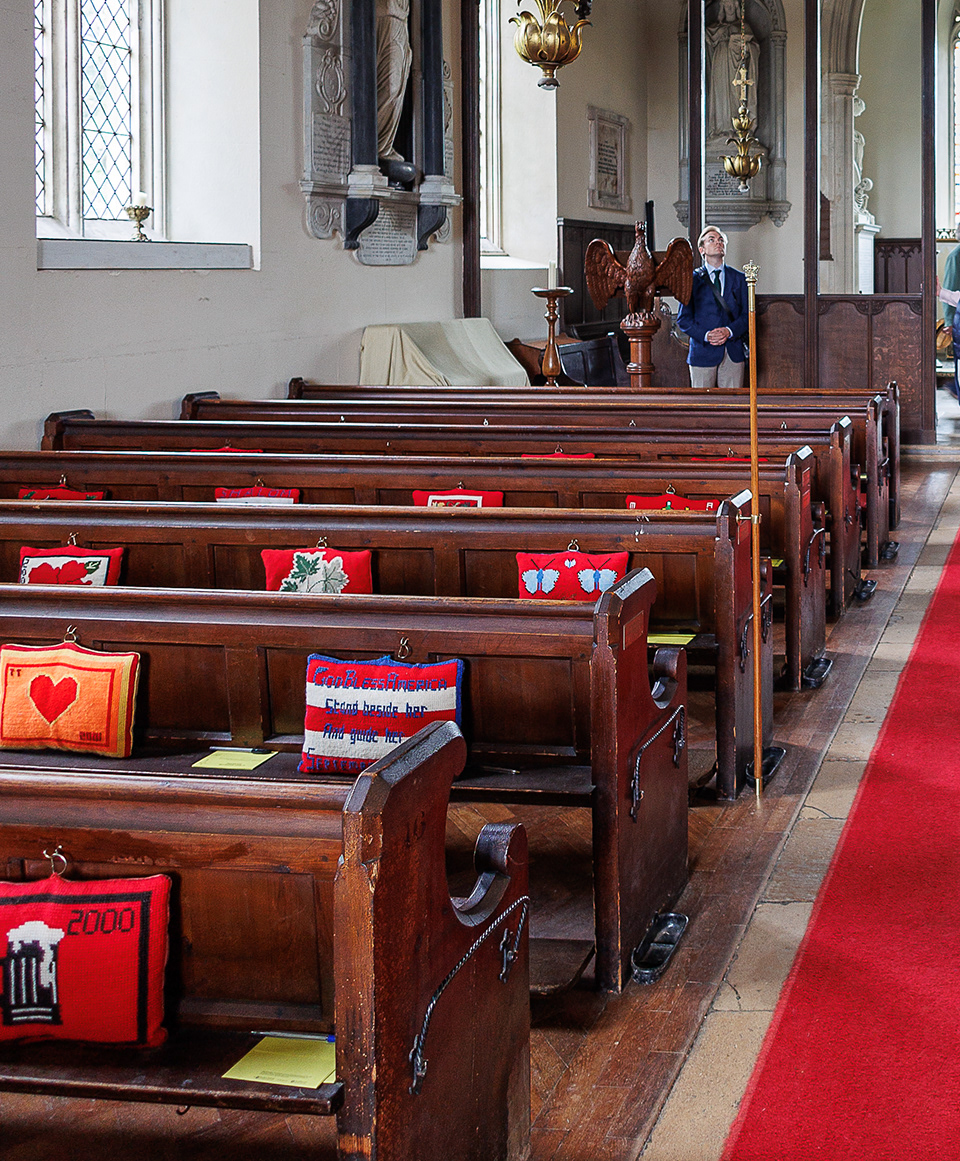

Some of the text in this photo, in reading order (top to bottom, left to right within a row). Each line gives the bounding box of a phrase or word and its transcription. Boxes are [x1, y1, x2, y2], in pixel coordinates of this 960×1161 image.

[221, 488, 292, 499] SHALOM
[325, 698, 428, 719] Stand beside her
[322, 722, 406, 745] And guide her
[67, 908, 135, 936] 2000
